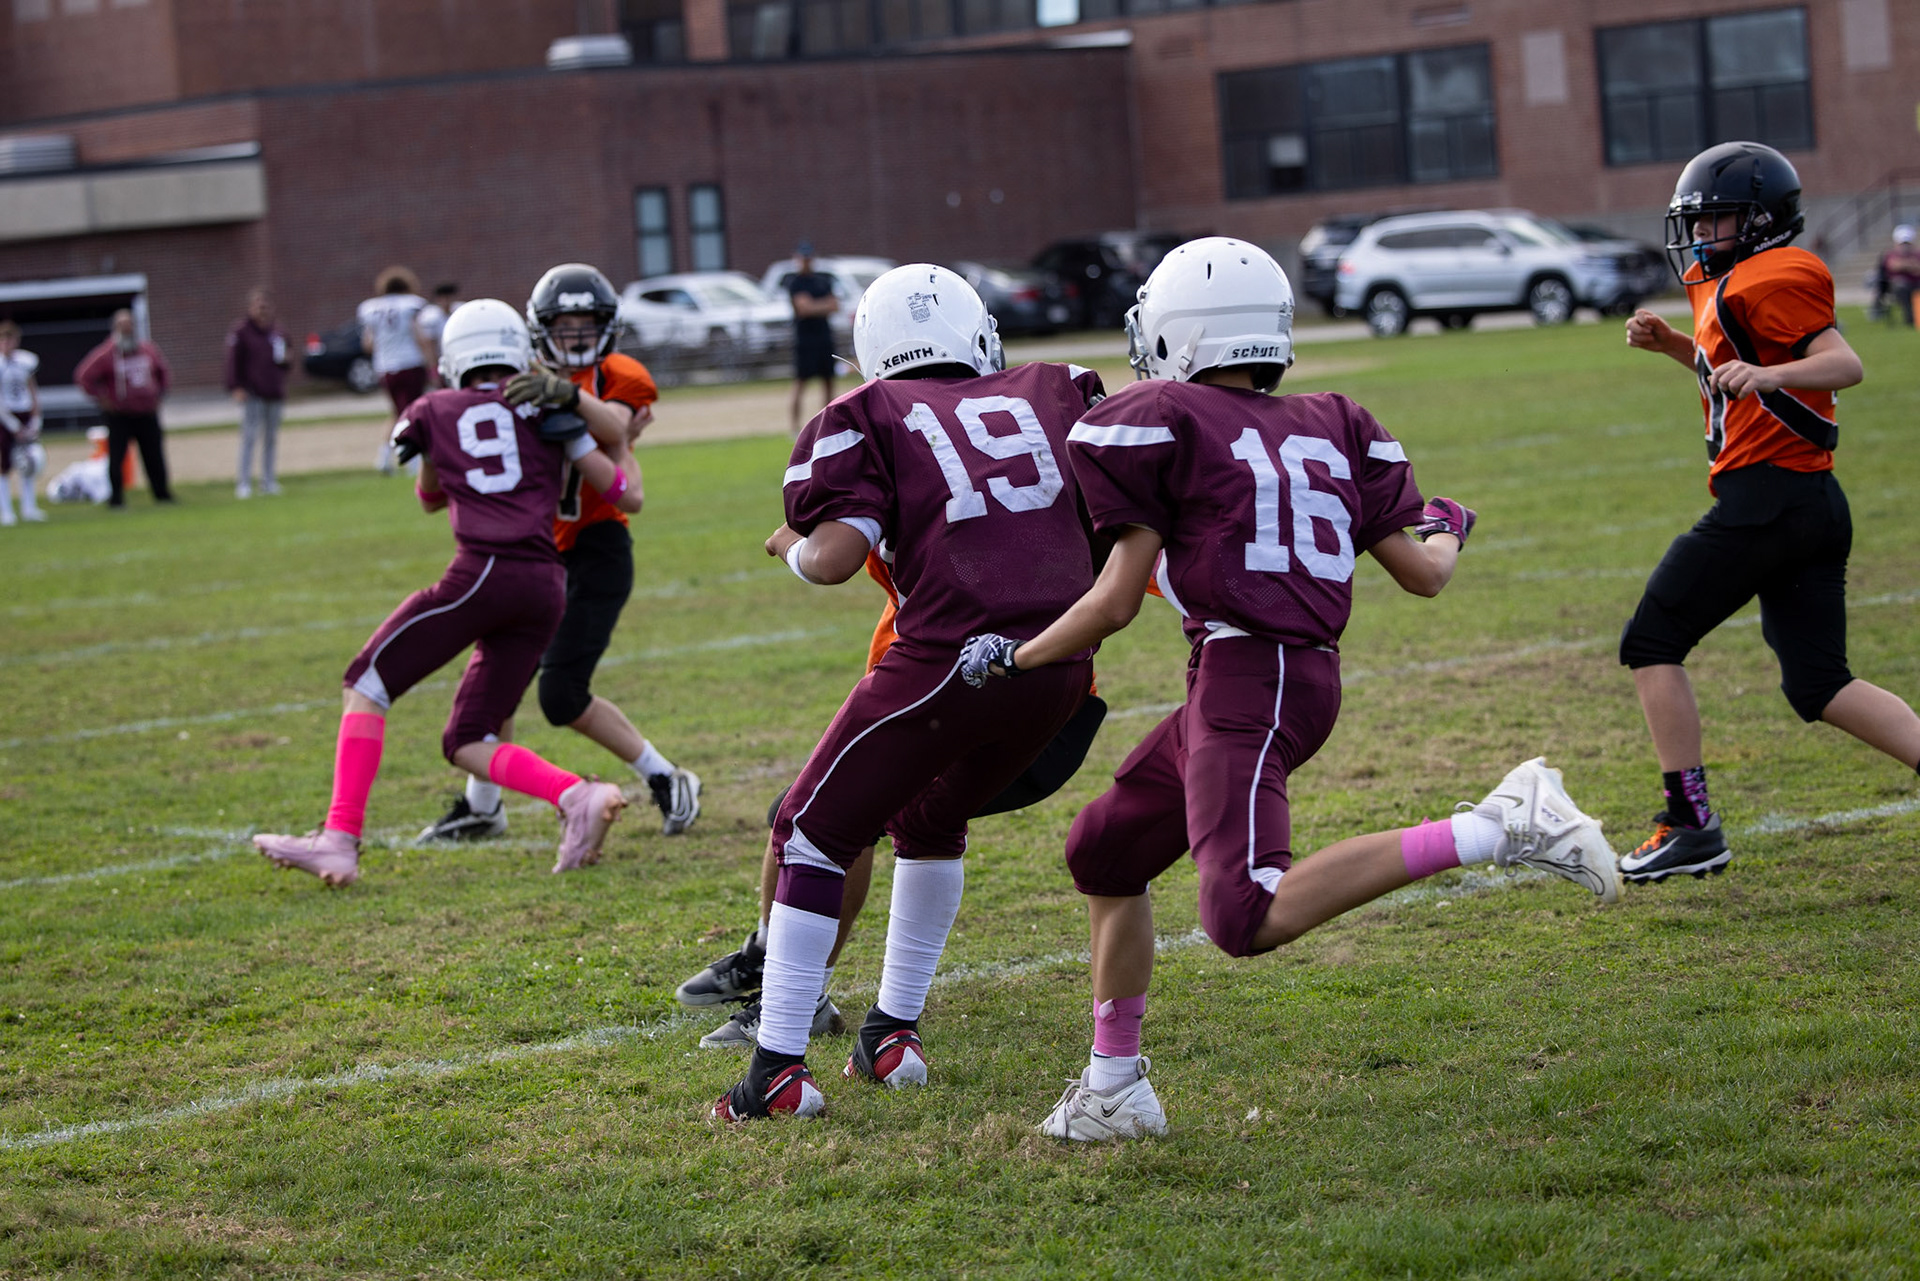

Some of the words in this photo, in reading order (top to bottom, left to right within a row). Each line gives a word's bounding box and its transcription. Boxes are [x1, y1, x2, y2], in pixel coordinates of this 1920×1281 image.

[882, 347, 934, 370] XENITH
[1232, 345, 1280, 359] schutt
[457, 401, 524, 495] 9
[903, 395, 1065, 524] 19
[1230, 427, 1356, 583] 16
